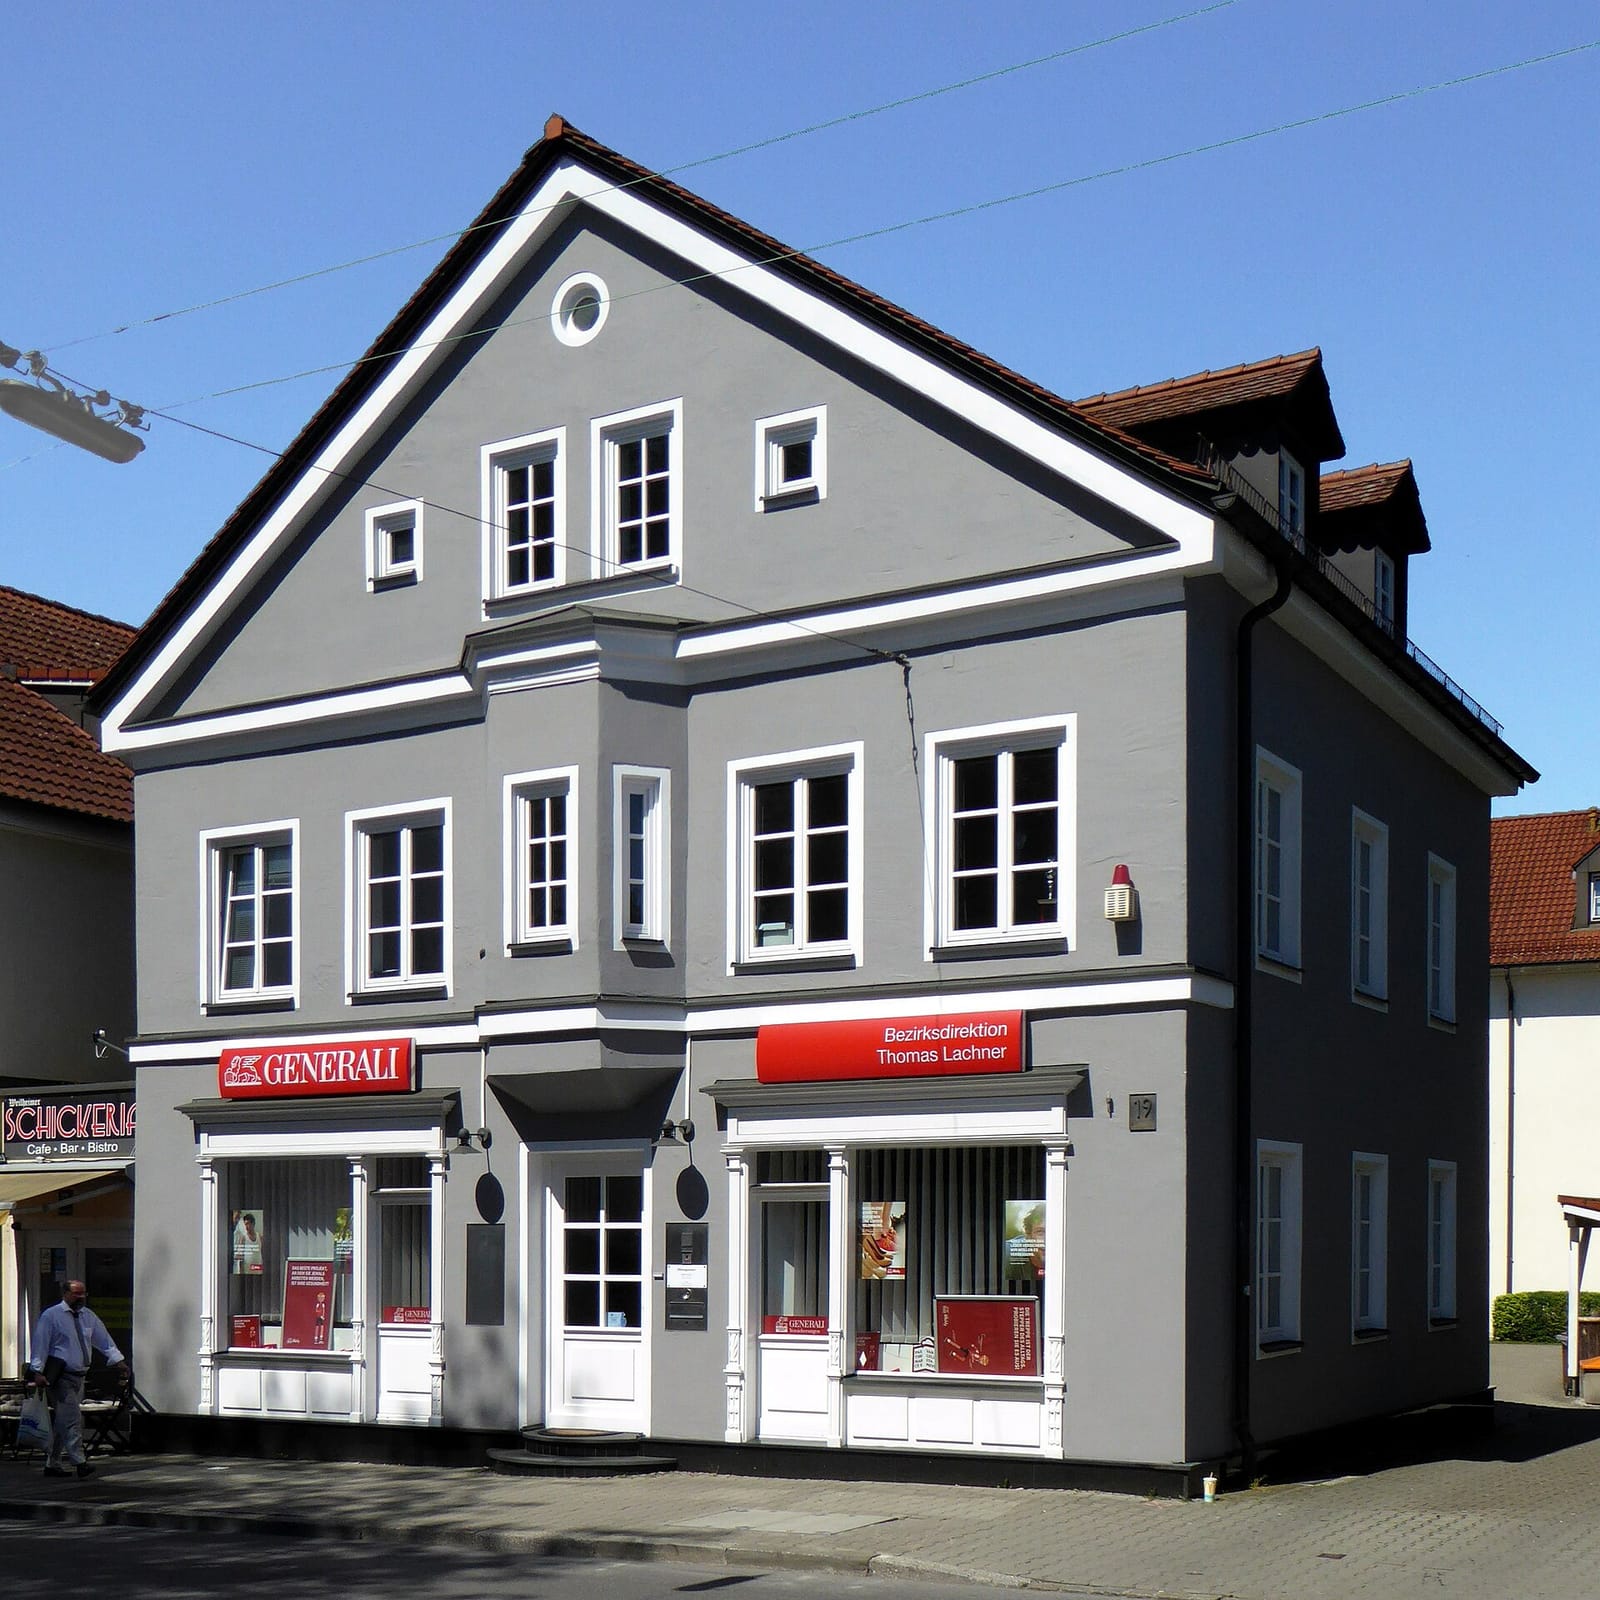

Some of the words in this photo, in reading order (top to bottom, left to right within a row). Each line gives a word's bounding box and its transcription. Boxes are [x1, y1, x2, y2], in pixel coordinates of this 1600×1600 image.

[884, 1022, 1008, 1043] Bezirksdirektion
[876, 1049, 939, 1065] Thomas
[943, 1045, 1008, 1062] Lachner
[263, 1047, 400, 1085] GENERALI
[27, 1143, 52, 1155] Cafe
[60, 1142, 79, 1154] Bar
[87, 1141, 119, 1153] Bistro
[789, 1319, 825, 1329] GENERALI
